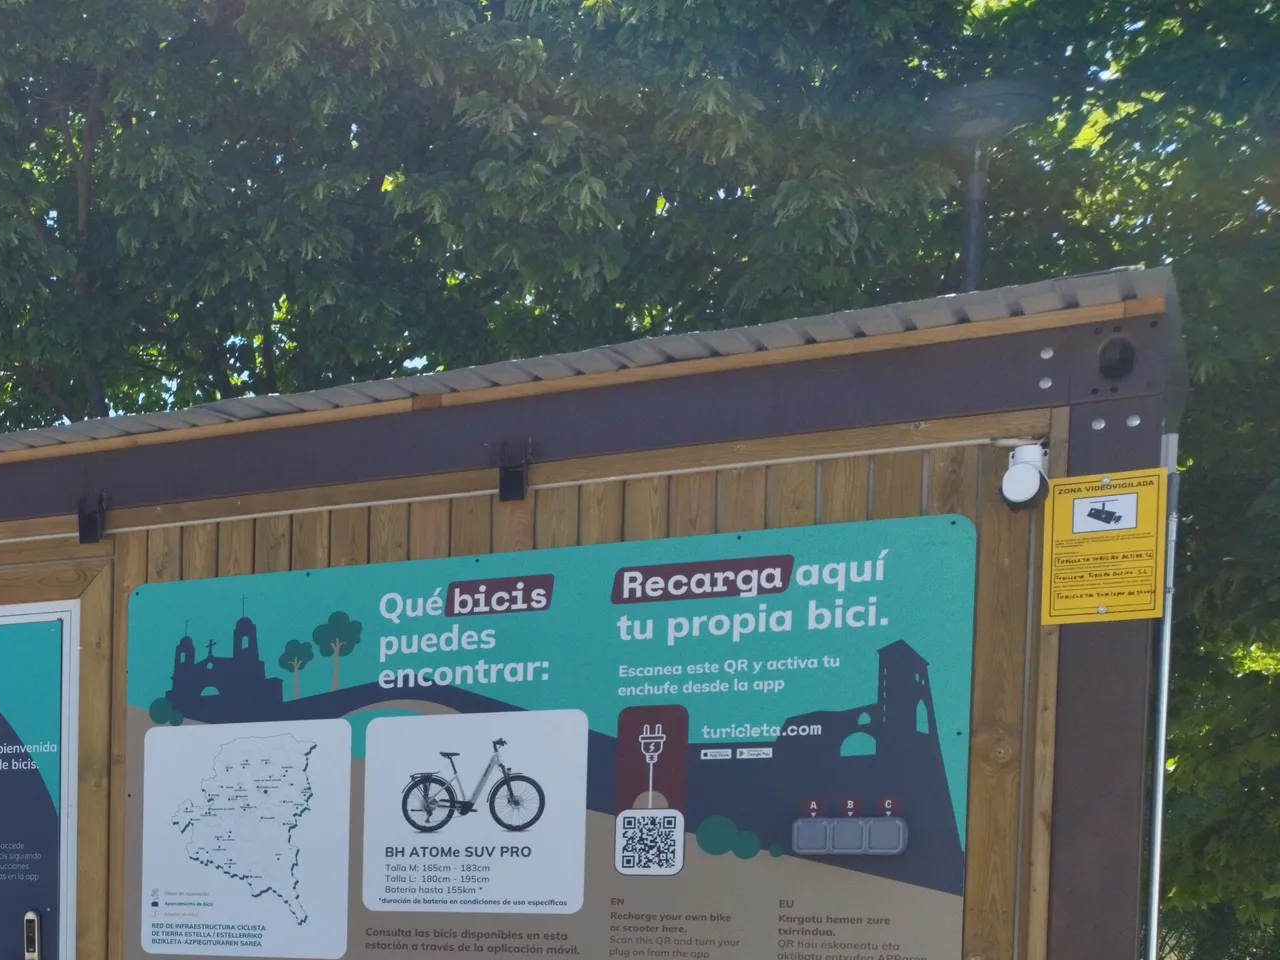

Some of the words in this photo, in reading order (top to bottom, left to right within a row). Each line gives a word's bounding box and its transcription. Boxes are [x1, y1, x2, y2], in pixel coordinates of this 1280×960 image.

[1058, 486, 1082, 495] ZONA
[1085, 480, 1154, 492] VIDEOVIGILADA
[622, 566, 782, 599] Recarga
[795, 549, 889, 592] aquí
[379, 587, 443, 624] Qué
[454, 581, 547, 614] bicis
[617, 616, 653, 641] tu
[667, 603, 792, 646] propia
[808, 596, 889, 630] bici.
[379, 624, 496, 662] puedes
[619, 665, 682, 678] Escanea
[687, 661, 719, 674] este
[724, 659, 748, 674] QR
[752, 662, 762, 674] y
[766, 657, 817, 670] activa
[822, 655, 840, 668] tu
[378, 659, 549, 688] encontrar:
[618, 680, 678, 696] enchufe
[682, 679, 729, 694] desde
[733, 677, 748, 692] la
[753, 679, 785, 694] app
[701, 723, 822, 739] turicleta.com
[11, 759, 40, 770] bicis.
[810, 801, 817, 809] A
[847, 801, 854, 809] B
[885, 800, 892, 808] C
[385, 847, 405, 858] BH
[409, 847, 460, 858] ATOMe
[465, 846, 496, 858] SUV
[500, 846, 532, 857] PRO
[385, 864, 406, 872] Talla
[409, 864, 420, 872] M:
[422, 864, 451, 872] 165cm
[461, 864, 490, 872] 183cm
[385, 875, 406, 883] Talla
[409, 875, 416, 883] L:
[422, 875, 450, 883] 180cm
[460, 875, 490, 883] 195cm
[385, 886, 416, 894] Batería
[419, 886, 443, 894] hasta
[446, 886, 476, 894] 155km
[528, 899, 567, 907] específicas
[779, 900, 794, 908] EU
[610, 912, 657, 922] Recharge
[660, 914, 682, 922] your
[710, 913, 731, 922] bike
[778, 914, 822, 925] Kargatu
[826, 915, 862, 924] hemen
[365, 928, 412, 938] Consulta
[415, 928, 430, 938] las
[433, 929, 458, 939] bicis
[461, 929, 523, 941] disponibles
[526, 932, 540, 940] en
[543, 932, 568, 941] esta
[662, 925, 687, 933] here.
[778, 927, 835, 936] txirrindua.
[365, 940, 408, 951] estación
[411, 943, 418, 951] a
[421, 942, 455, 952] través
[457, 942, 470, 952] de
[474, 943, 484, 952] la
[487, 943, 543, 956] aplicación
[547, 945, 580, 955] móvil.
